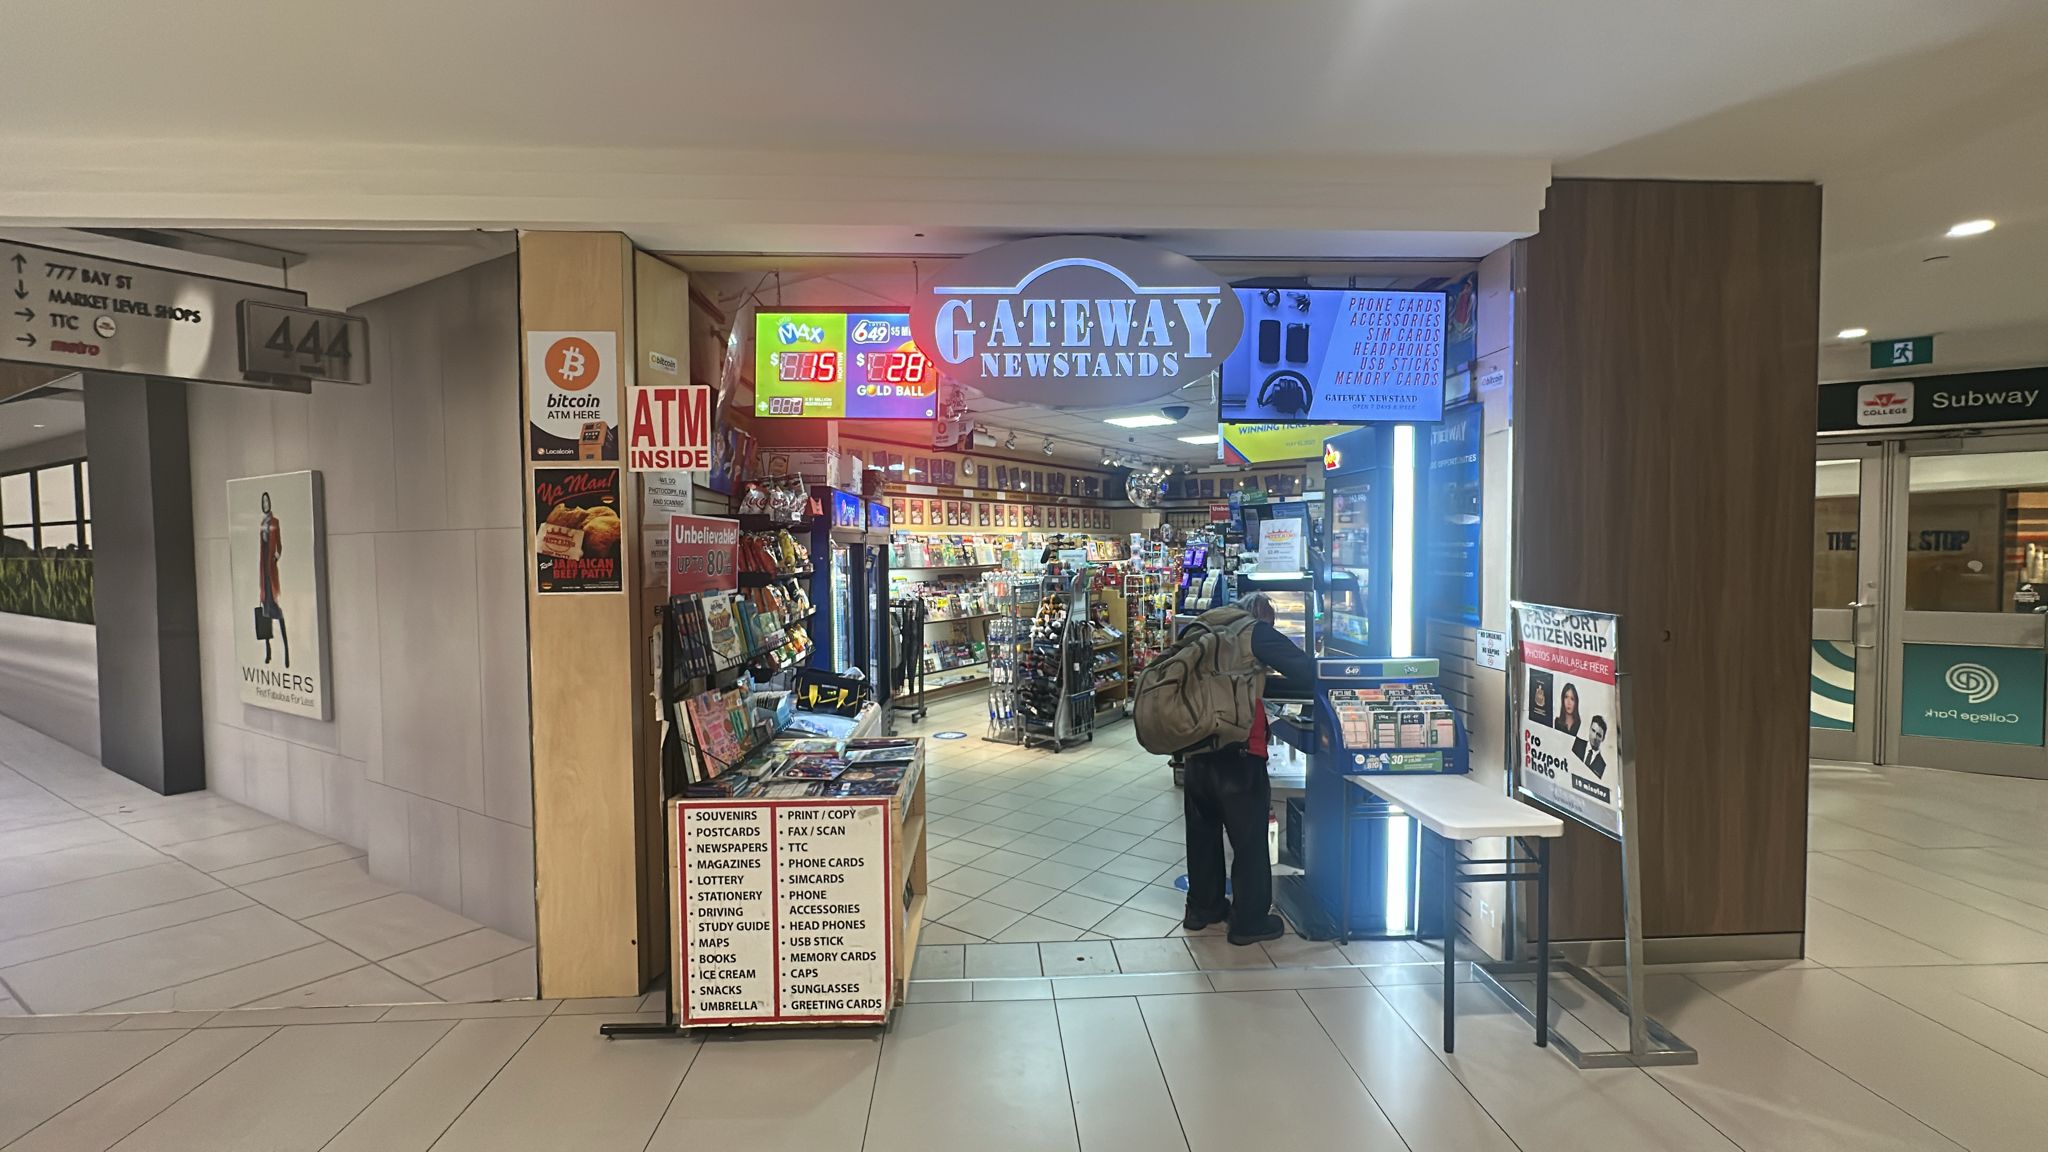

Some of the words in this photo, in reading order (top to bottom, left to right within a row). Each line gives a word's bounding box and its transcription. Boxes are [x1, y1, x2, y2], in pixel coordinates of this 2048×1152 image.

[45, 263, 77, 281] 777
[81, 269, 111, 286] BAY
[116, 275, 132, 290] ST
[48, 289, 109, 310] MARKET
[113, 298, 152, 317] LEVEL
[155, 304, 201, 323] SHOPS
[1349, 298, 1392, 311] PHONE
[1399, 298, 1441, 312] CARDS
[49, 313, 79, 330] TTC
[1350, 313, 1441, 327] ACCESSORIES
[778, 323, 822, 344] MAX
[855, 322, 888, 341] 649
[1367, 328, 1391, 341] SIM
[1398, 328, 1440, 342] CARDS
[265, 316, 352, 365] 444
[1353, 342, 1440, 356] HEADPHONES
[656, 356, 676, 369] bitcoin
[981, 352, 1179, 378] NEWSTANDS
[1361, 357, 1385, 370] USB
[1392, 357, 1439, 371] STICKS
[1335, 371, 1390, 384] MEMORY
[1397, 372, 1439, 385] CARDS
[896, 386, 924, 396] BALL
[547, 394, 600, 408] bitcoin
[1325, 394, 1366, 402] GATEWAY
[1370, 394, 1418, 402] NEWSTAND
[1932, 389, 2039, 409] Subway
[547, 411, 571, 419] ATM
[573, 410, 600, 419] HERE
[1863, 407, 1907, 416] COLLEGE
[631, 388, 708, 447] ATM
[1238, 424, 1280, 435] WINNING
[631, 450, 709, 469] INSIDE
[675, 524, 737, 545] Unbelievable!
[1826, 531, 1857, 551] THE
[1920, 530, 1970, 551] STOP
[553, 558, 614, 569] JAMAICAN
[677, 556, 690, 574] UP
[707, 549, 724, 576] 80
[553, 569, 578, 579] BEEF
[581, 568, 613, 578] PATTY
[1523, 623, 1607, 652] CITIZENSHIP
[1525, 648, 1550, 662] PHOTOS
[1551, 654, 1588, 671] AVAILABLE
[1589, 661, 1609, 676] HERE
[242, 666, 314, 693] WINNERS
[1525, 729, 1541, 747] Pro
[1391, 754, 1404, 765] 30
[1525, 742, 1568, 772] Passport
[1525, 755, 1555, 779] Photo
[1583, 782, 1607, 798] minutes
[696, 810, 757, 821] SOUVENIRS
[787, 810, 819, 820] PRINT
[828, 809, 856, 819] COPY
[696, 827, 760, 837] POSTCARDS
[788, 826, 808, 836] FAX
[816, 826, 846, 836] SCAN
[697, 842, 768, 853] NEWSPAPERS
[788, 842, 808, 852] TTC
[697, 859, 761, 869] MAGAZINES
[789, 858, 826, 868] PHONE
[829, 857, 864, 867] CARDS
[698, 875, 744, 885] LOTTERY
[789, 874, 844, 884] SIMCARDS
[698, 891, 762, 901] STATIONERY
[789, 890, 827, 900] PHONE
[698, 907, 743, 917] DRIVING
[789, 904, 860, 914] ACCESSORIES
[698, 922, 733, 932] STUDY
[736, 921, 770, 931] GUIDE
[789, 921, 820, 931] HEAD
[822, 920, 866, 930] PHONES
[699, 938, 730, 948] MAPS
[790, 936, 811, 946] USB
[814, 936, 844, 946] STICK
[700, 954, 736, 963] BOOKS
[790, 952, 837, 962] MEMORY
[841, 951, 876, 961] CARDS
[700, 970, 716, 980] ICE
[718, 969, 756, 979] CREAM
[790, 968, 818, 978] CAPS
[700, 985, 742, 995] SNACKS
[791, 983, 860, 994] SUNGLASSES
[700, 1001, 758, 1012] UMBRELLA
[791, 1000, 844, 1010] GREETING
[846, 999, 882, 1009] CARDS
